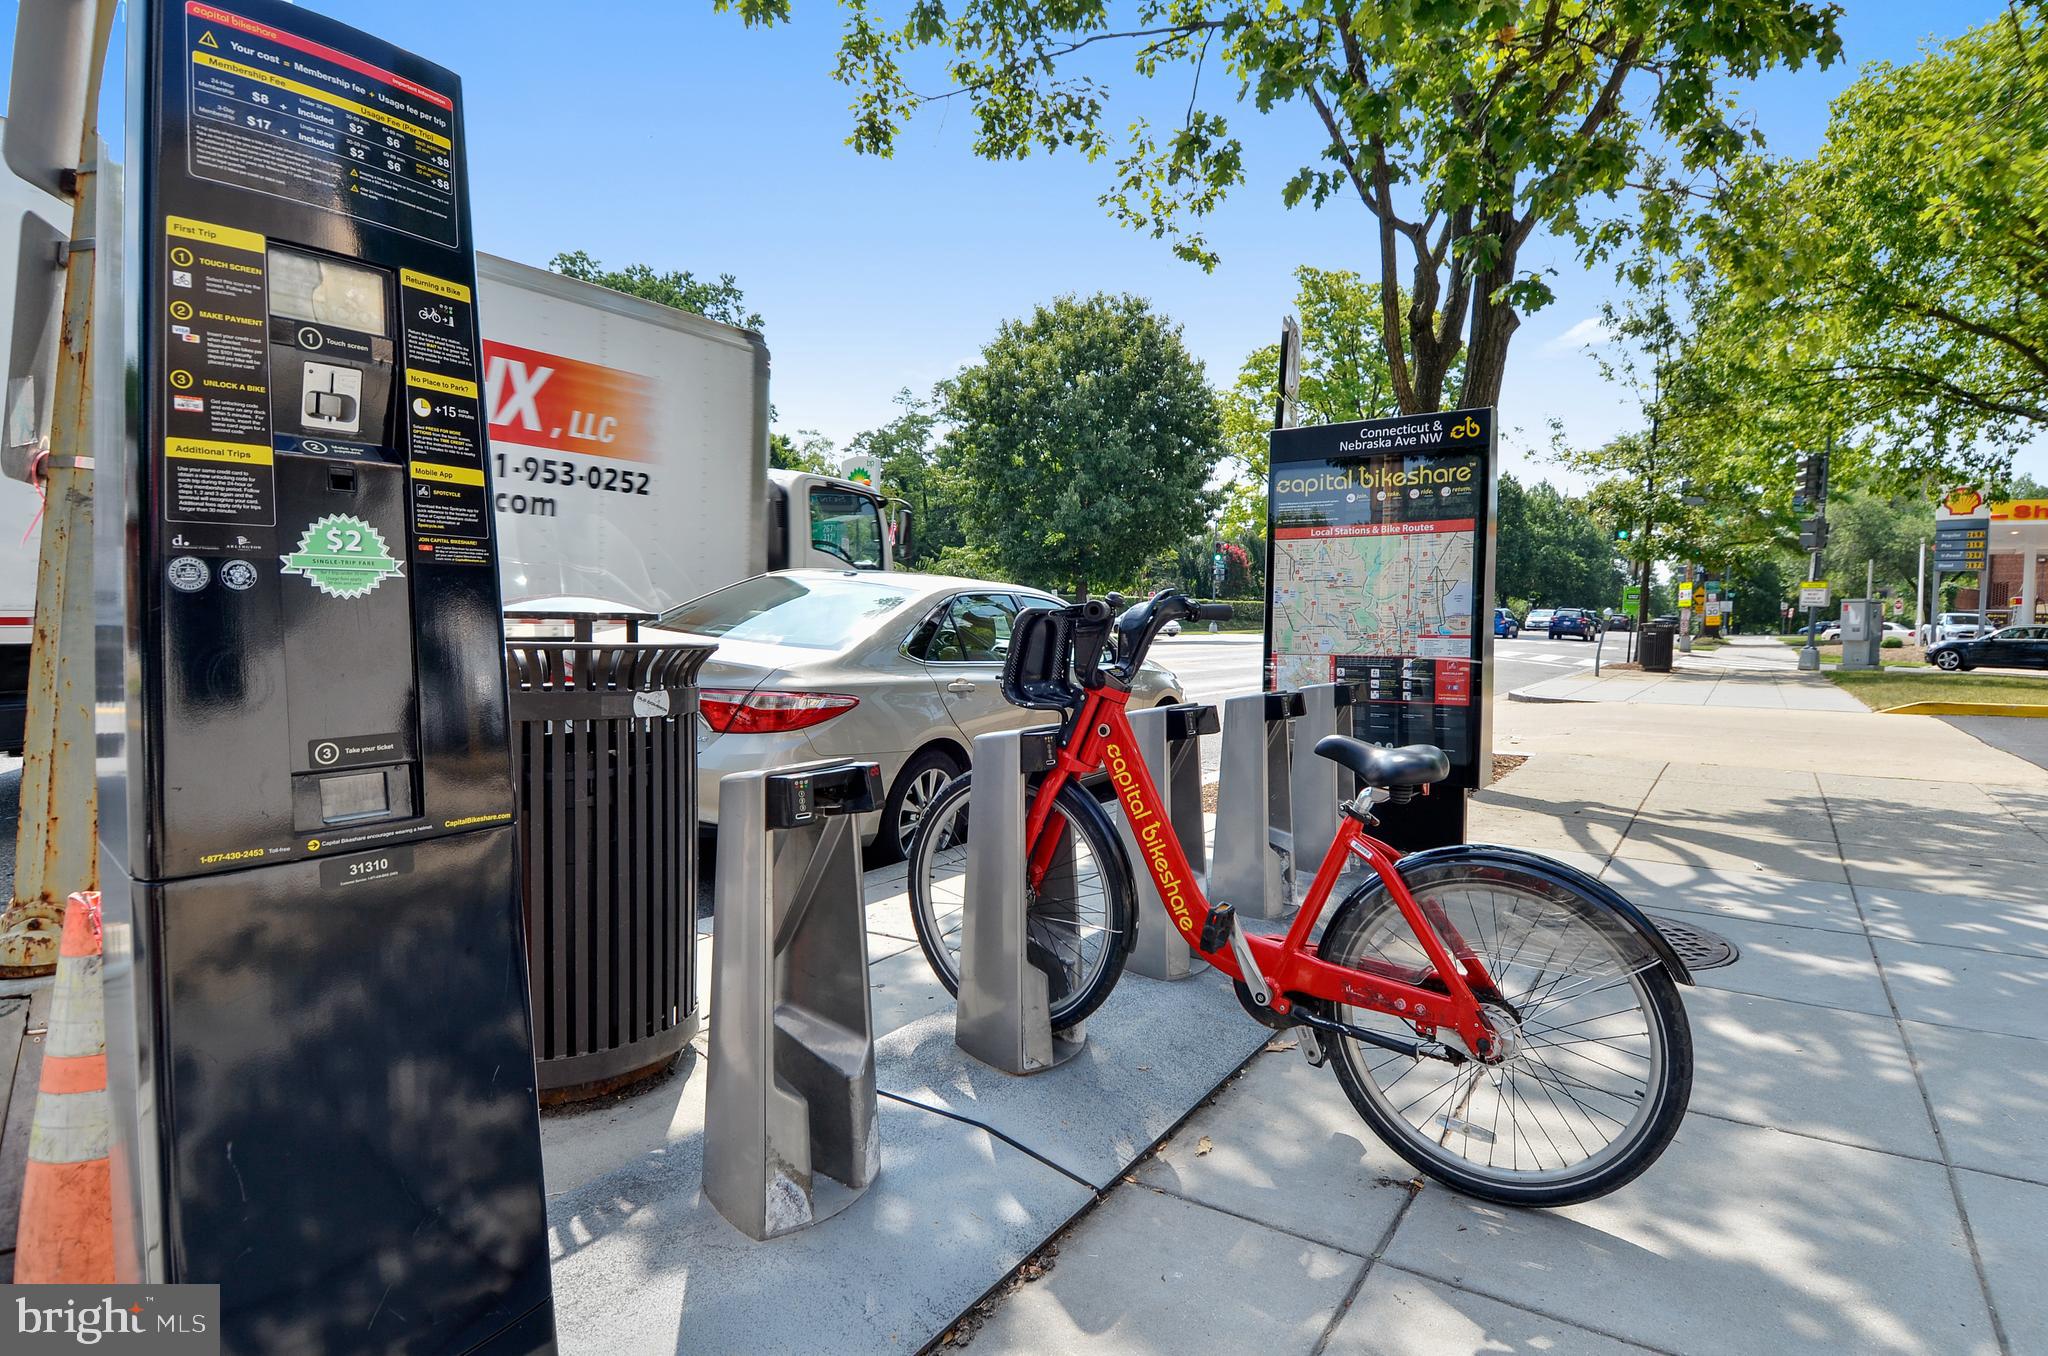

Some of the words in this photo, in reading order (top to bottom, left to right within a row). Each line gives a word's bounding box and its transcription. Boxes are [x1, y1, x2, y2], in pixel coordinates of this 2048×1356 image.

[208, 57, 267, 81] Membership
[270, 76, 286, 87] Fee
[230, 41, 255, 55] Your
[257, 51, 280, 64] cost
[294, 62, 350, 89] Membership
[352, 83, 366, 95] fee
[378, 93, 405, 110] Usage
[406, 105, 418, 116] fee
[419, 111, 432, 122] per
[433, 116, 447, 128] trip
[252, 91, 269, 104] $8
[246, 115, 272, 131] $17
[297, 108, 334, 125] Included
[360, 106, 385, 123] Usage
[387, 116, 401, 128] Fee
[402, 122, 417, 134] (Per
[419, 128, 435, 141] Trip)
[349, 122, 364, 136] $2
[298, 132, 335, 150] Included
[386, 136, 400, 149] $6
[349, 147, 365, 160] $2
[387, 160, 401, 172] $6
[173, 223, 195, 234] First
[198, 228, 217, 239] Trip
[199, 257, 228, 269] TOUCH
[229, 263, 262, 275] SCREEN
[405, 275, 440, 291] Returning
[446, 286, 461, 296] Bike
[199, 310, 224, 321] MAKE
[225, 314, 263, 327] PAYMENT
[326, 337, 346, 349] Touch
[347, 342, 369, 352] screen
[203, 379, 238, 390] UNLOCK
[239, 383, 246, 391] A
[247, 384, 266, 394] BIKE
[410, 375, 421, 383] No
[422, 378, 441, 387] Place
[450, 384, 469, 393] Park?
[1360, 423, 1430, 439] Connecticut
[1433, 420, 1443, 431] &
[1339, 436, 1392, 451] Nebraska
[1395, 435, 1417, 446] Ave
[1420, 432, 1443, 443] NW
[175, 445, 225, 456] Additional
[227, 450, 251, 460] Trips
[415, 468, 438, 477] Mobile
[439, 471, 453, 479] App
[1276, 469, 1353, 497] capital
[1359, 464, 1472, 490] bikeshare
[1310, 526, 1333, 537] Local
[1335, 523, 1371, 536] Stations
[1372, 525, 1380, 534] &
[1381, 523, 1401, 534] Bike
[1403, 523, 1434, 532] Routes
[326, 527, 362, 552] $2
[322, 748, 332, 759] 3
[361, 746, 376, 754] your
[444, 813, 511, 829] CapitalBikeshare.com
[321, 839, 341, 847] Capital
[341, 836, 367, 845] Bikeshare
[367, 831, 395, 841] encourages
[1106, 744, 1152, 820] capital
[1142, 821, 1193, 931] bikeshare
[200, 848, 265, 864] 1-877-430-2453
[349, 858, 388, 875] 31310
